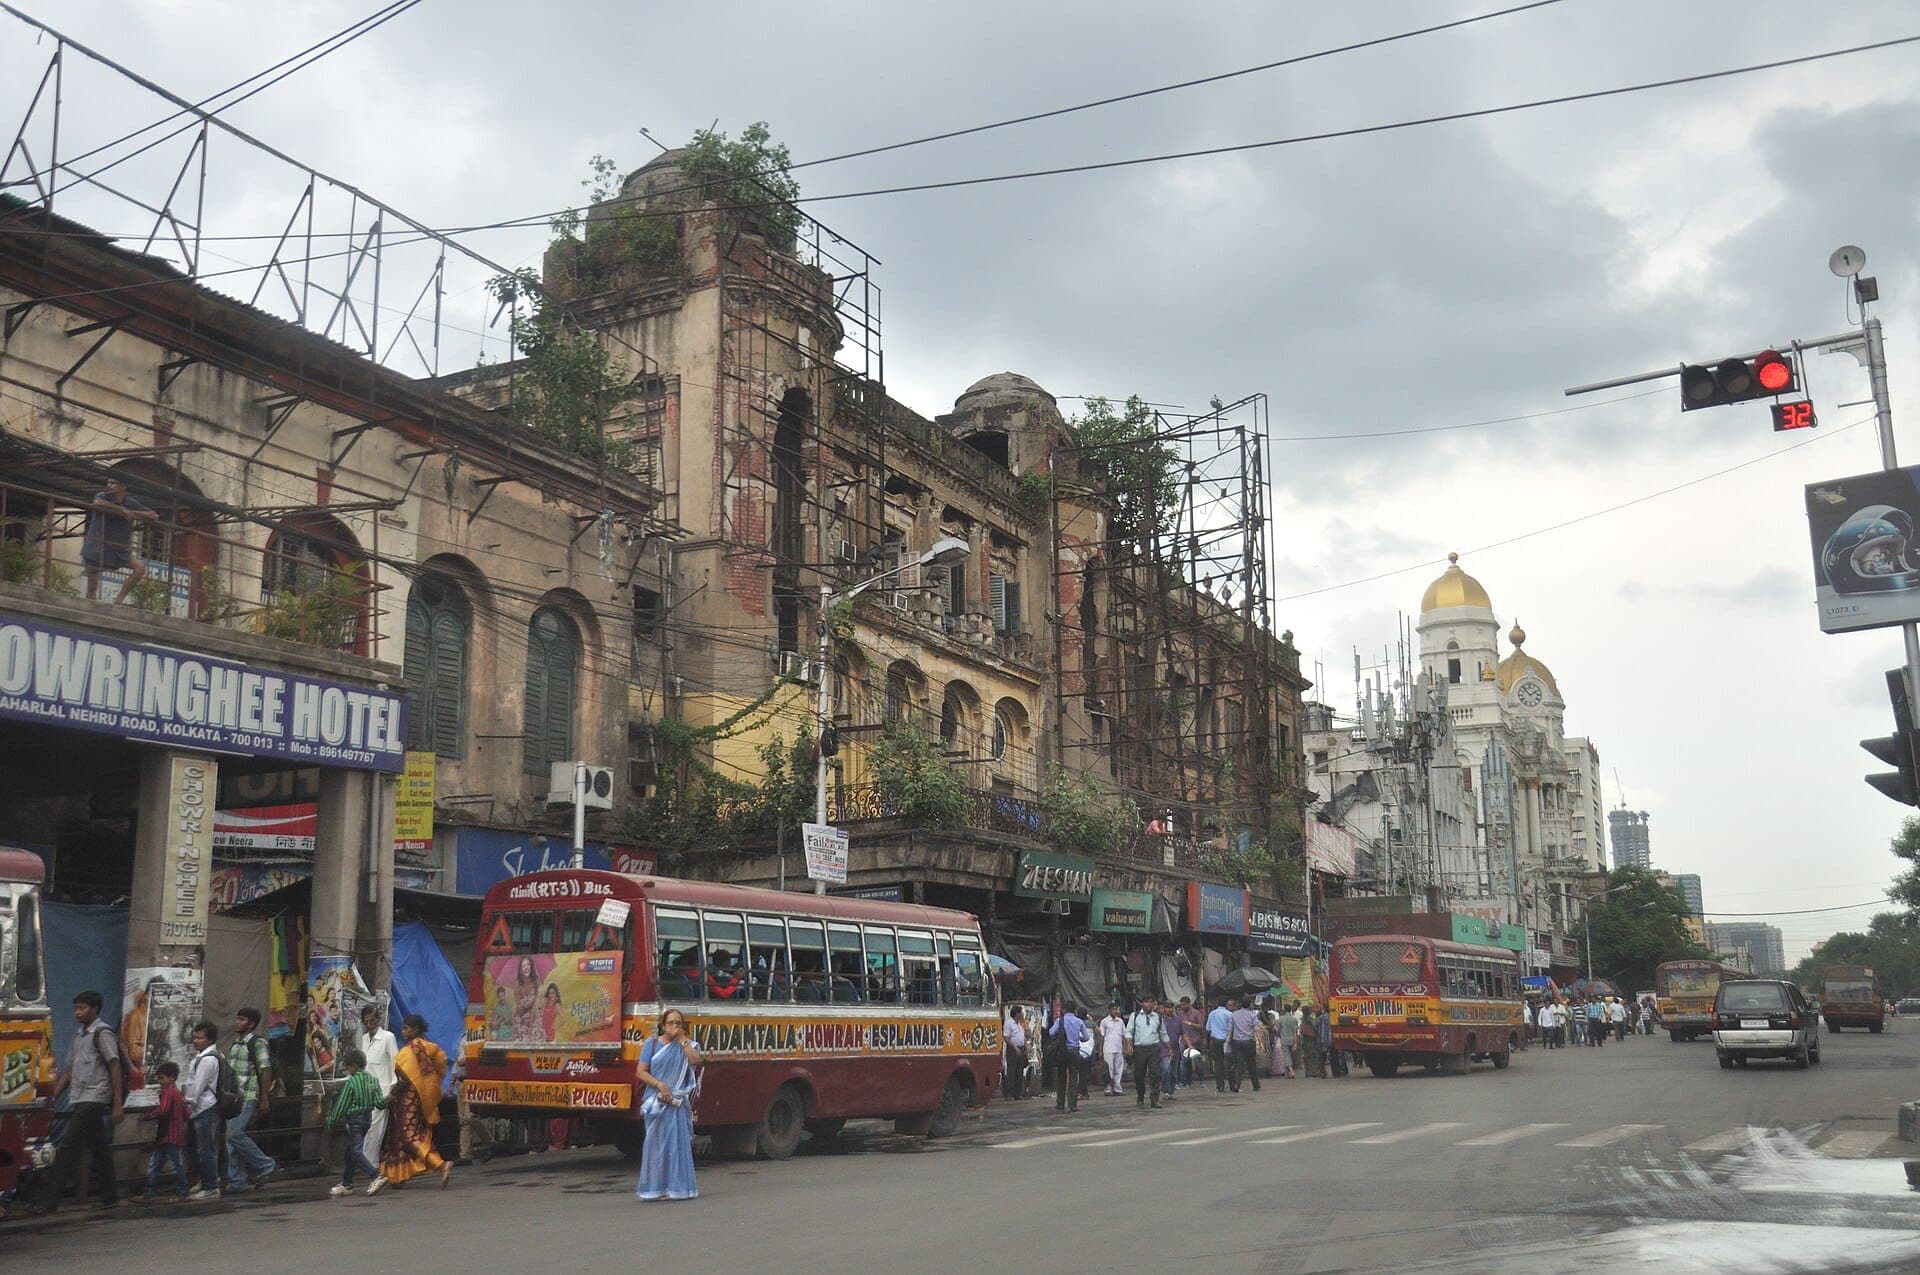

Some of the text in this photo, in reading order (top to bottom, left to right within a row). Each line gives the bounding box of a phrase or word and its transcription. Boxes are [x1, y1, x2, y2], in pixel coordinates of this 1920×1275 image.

[1782, 403, 1811, 429] 32
[292, 682, 403, 754] HOTEL
[70, 707, 118, 726] NEHRU
[121, 715, 160, 735] ROAD,
[164, 722, 221, 743] KOLKATA
[231, 732, 251, 747] 700
[253, 735, 273, 749] 013
[291, 741, 311, 756] Mob
[175, 765, 207, 917] CHOWRINGHEE
[228, 836, 254, 846] Neera
[584, 881, 614, 896] Bus.
[1022, 863, 1093, 896] ZEESHAN
[165, 921, 206, 938] HOTEL
[1105, 911, 1127, 924] value
[1360, 999, 1404, 1017] HOWRAH
[694, 1023, 797, 1054] KADAMTALA
[803, 1023, 863, 1053] HOWRAH
[870, 1023, 944, 1052] ESPLANADE
[466, 1084, 500, 1104] Horn
[570, 1086, 619, 1108] Please
